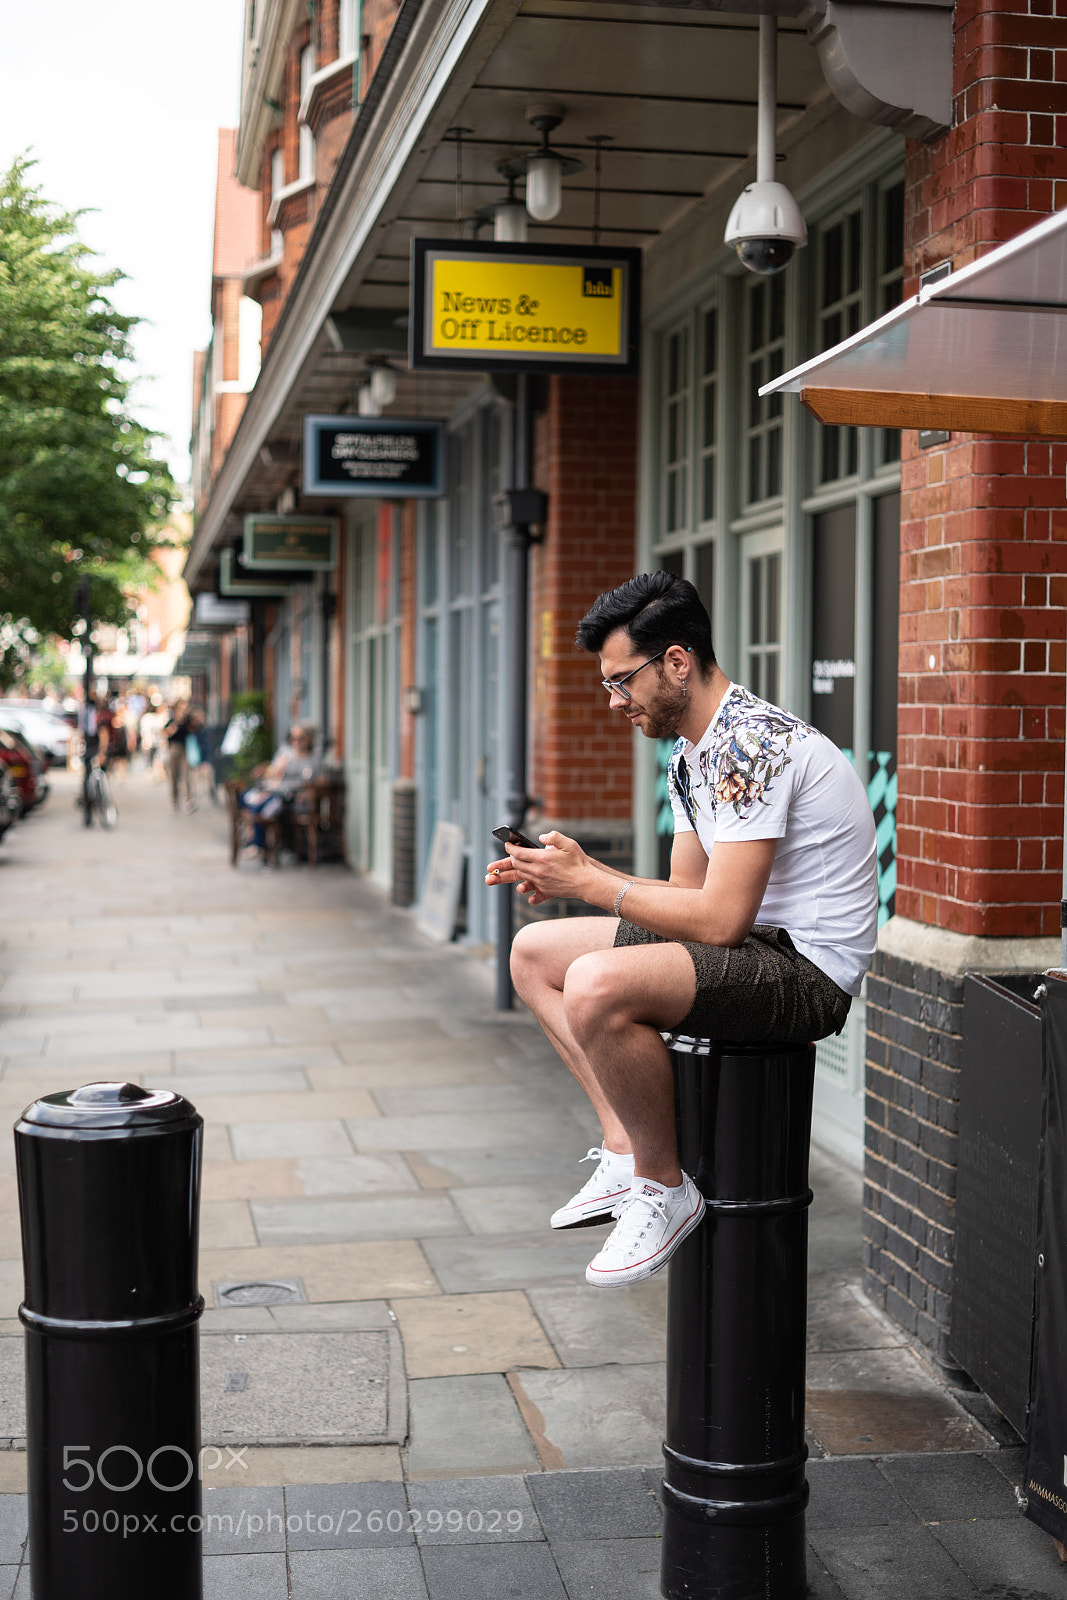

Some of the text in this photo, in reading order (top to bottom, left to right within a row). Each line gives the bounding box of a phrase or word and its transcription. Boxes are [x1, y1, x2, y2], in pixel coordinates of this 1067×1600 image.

[441, 291, 540, 316] News &
[440, 318, 588, 345] Off Licence
